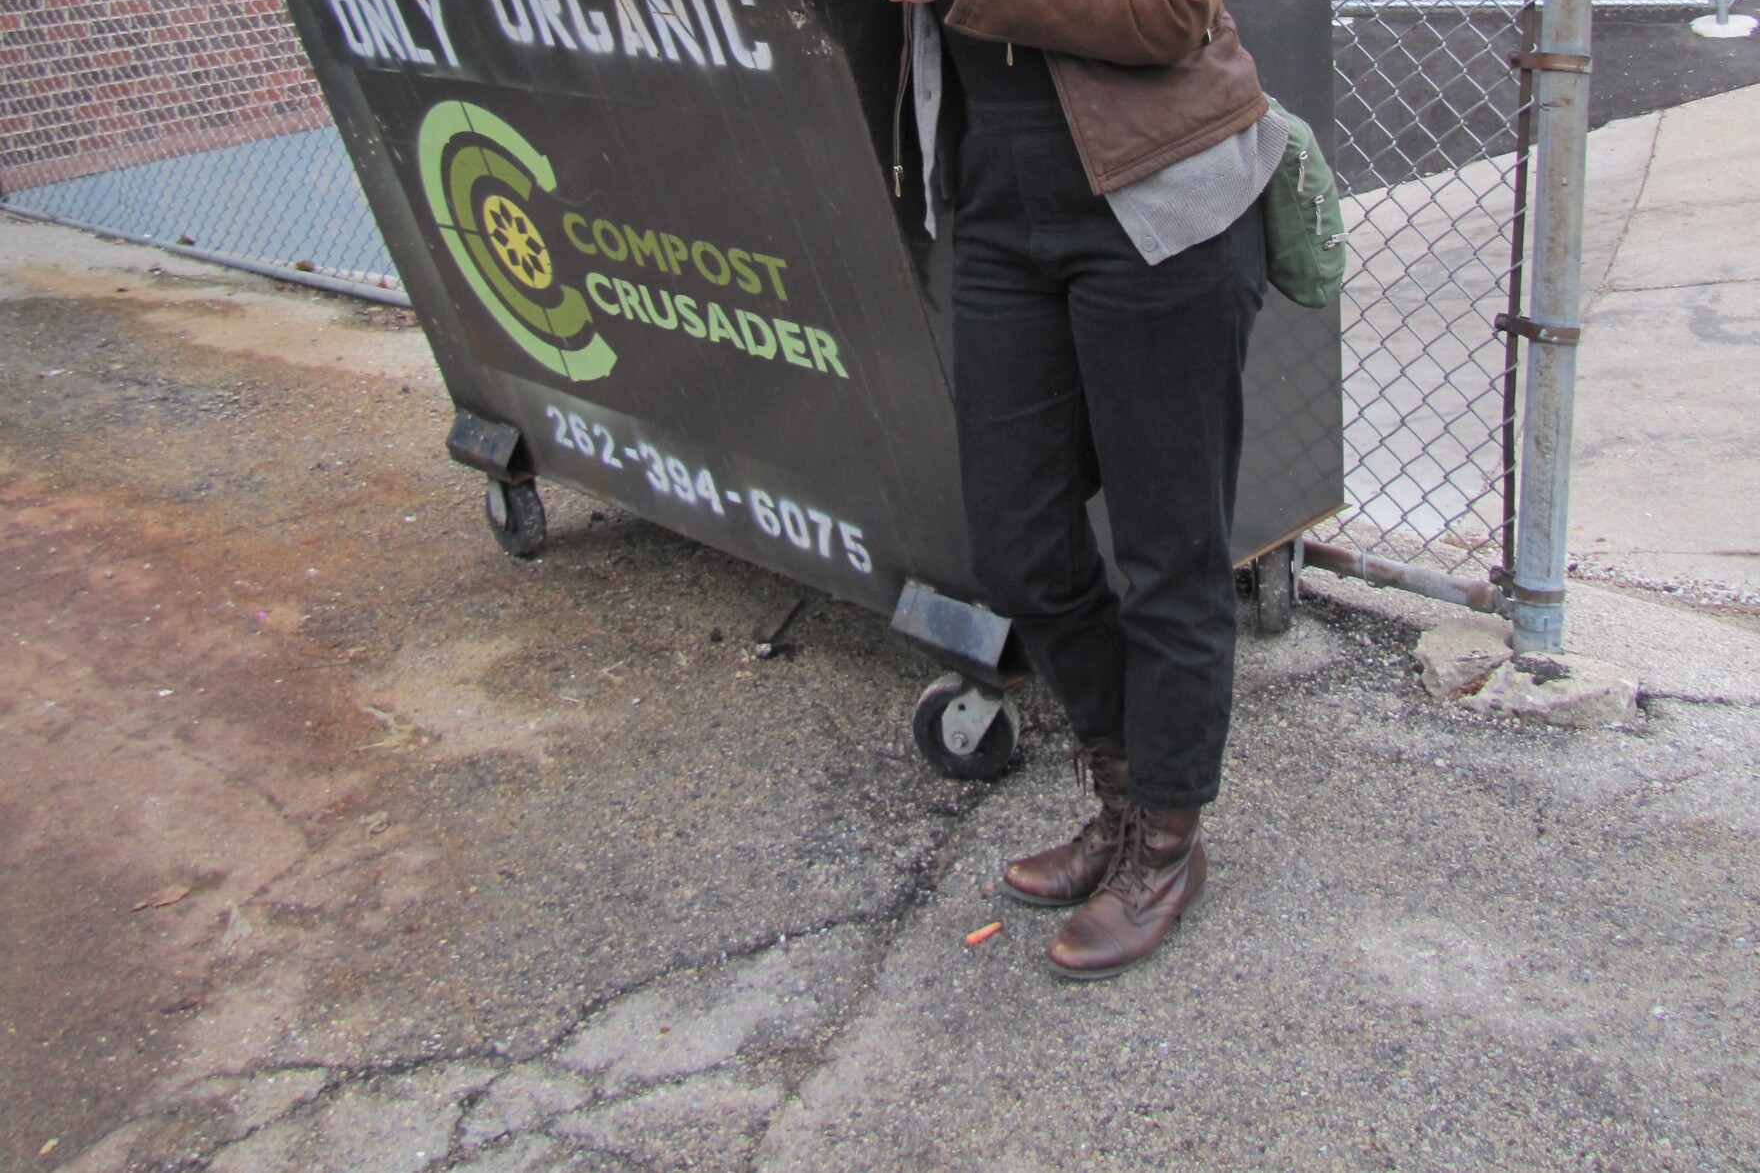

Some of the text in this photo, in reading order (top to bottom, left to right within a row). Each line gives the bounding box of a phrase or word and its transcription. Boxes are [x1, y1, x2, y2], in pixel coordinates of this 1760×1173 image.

[563, 211, 788, 302] COMPOST
[586, 272, 850, 379] CRUSADER
[546, 404, 873, 574] 262-394-6075
